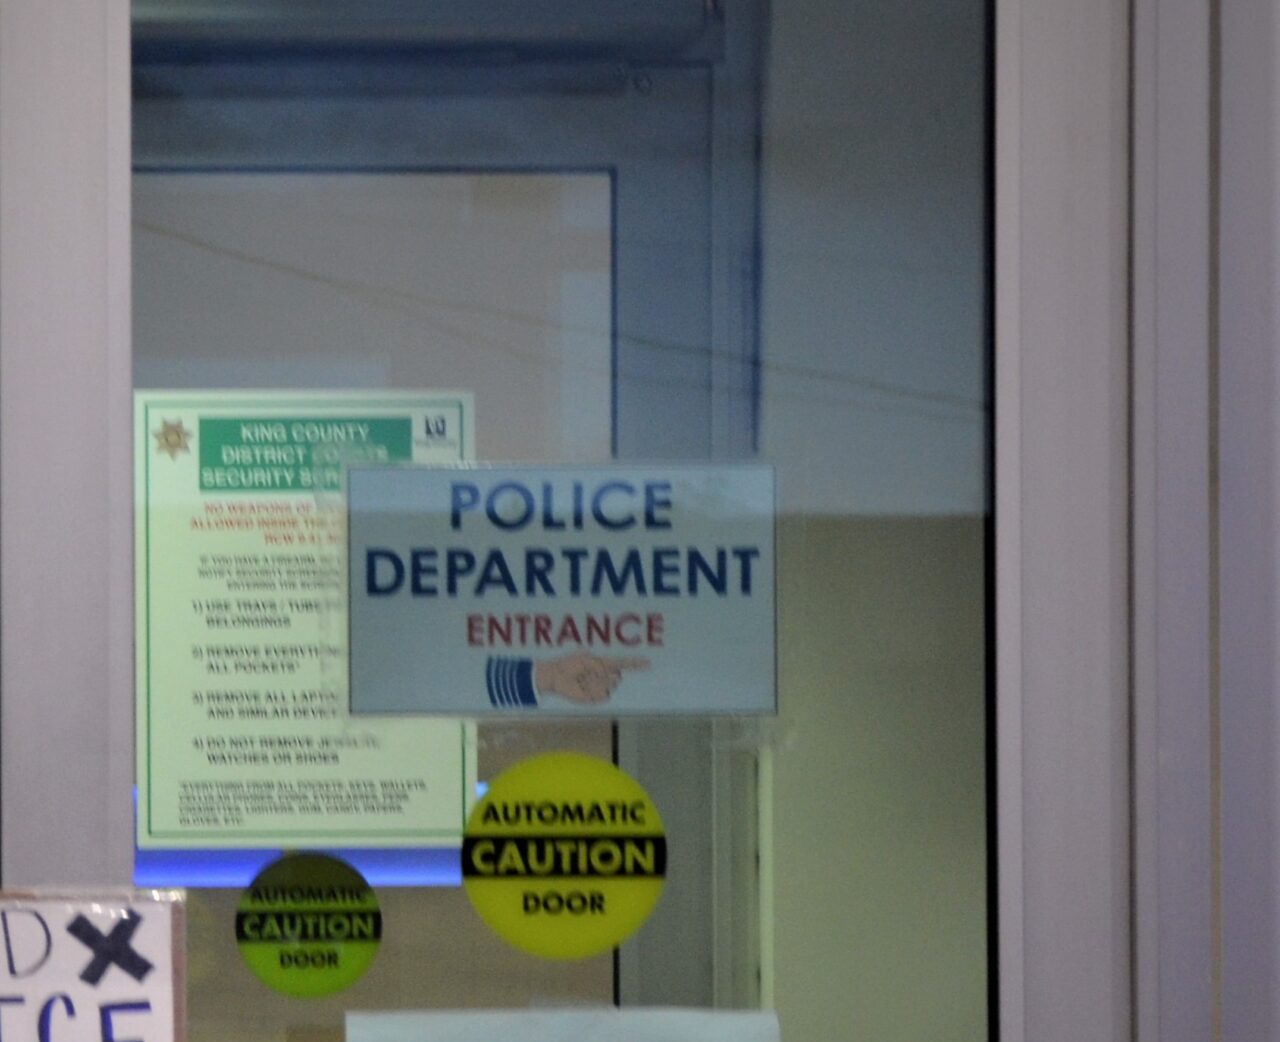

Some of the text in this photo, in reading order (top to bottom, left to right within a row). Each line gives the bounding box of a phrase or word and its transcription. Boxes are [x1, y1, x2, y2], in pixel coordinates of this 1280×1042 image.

[241, 422, 370, 442] KING COUNTY
[222, 445, 306, 465] DISTRICT
[201, 468, 295, 488] SECURITY
[450, 480, 673, 531] POLICE
[190, 516, 254, 531] ALLOWED
[365, 547, 760, 598] DEPARTMENT
[206, 600, 231, 612] USE
[237, 600, 277, 612] TRAYS
[206, 615, 291, 628] BELONGINGS
[466, 613, 664, 647] ENTRANCE
[206, 645, 260, 658] REMOVE
[207, 661, 231, 674] ALL
[206, 691, 260, 703] REMOVE
[264, 691, 287, 703] ALL
[207, 707, 234, 719] AND
[238, 707, 290, 719] SIMILAR
[207, 737, 226, 749] DO
[229, 737, 255, 749] NOT
[259, 737, 313, 749] REMOVE
[207, 752, 339, 765] WATCHES OR SHOES
[482, 802, 646, 825] AUTOMATIC
[471, 840, 655, 874] CAUTION
[251, 886, 368, 904] AUTOMATIC
[523, 891, 606, 914] DOOR
[243, 915, 376, 940] CAUTION
[279, 950, 339, 969] DOOR
